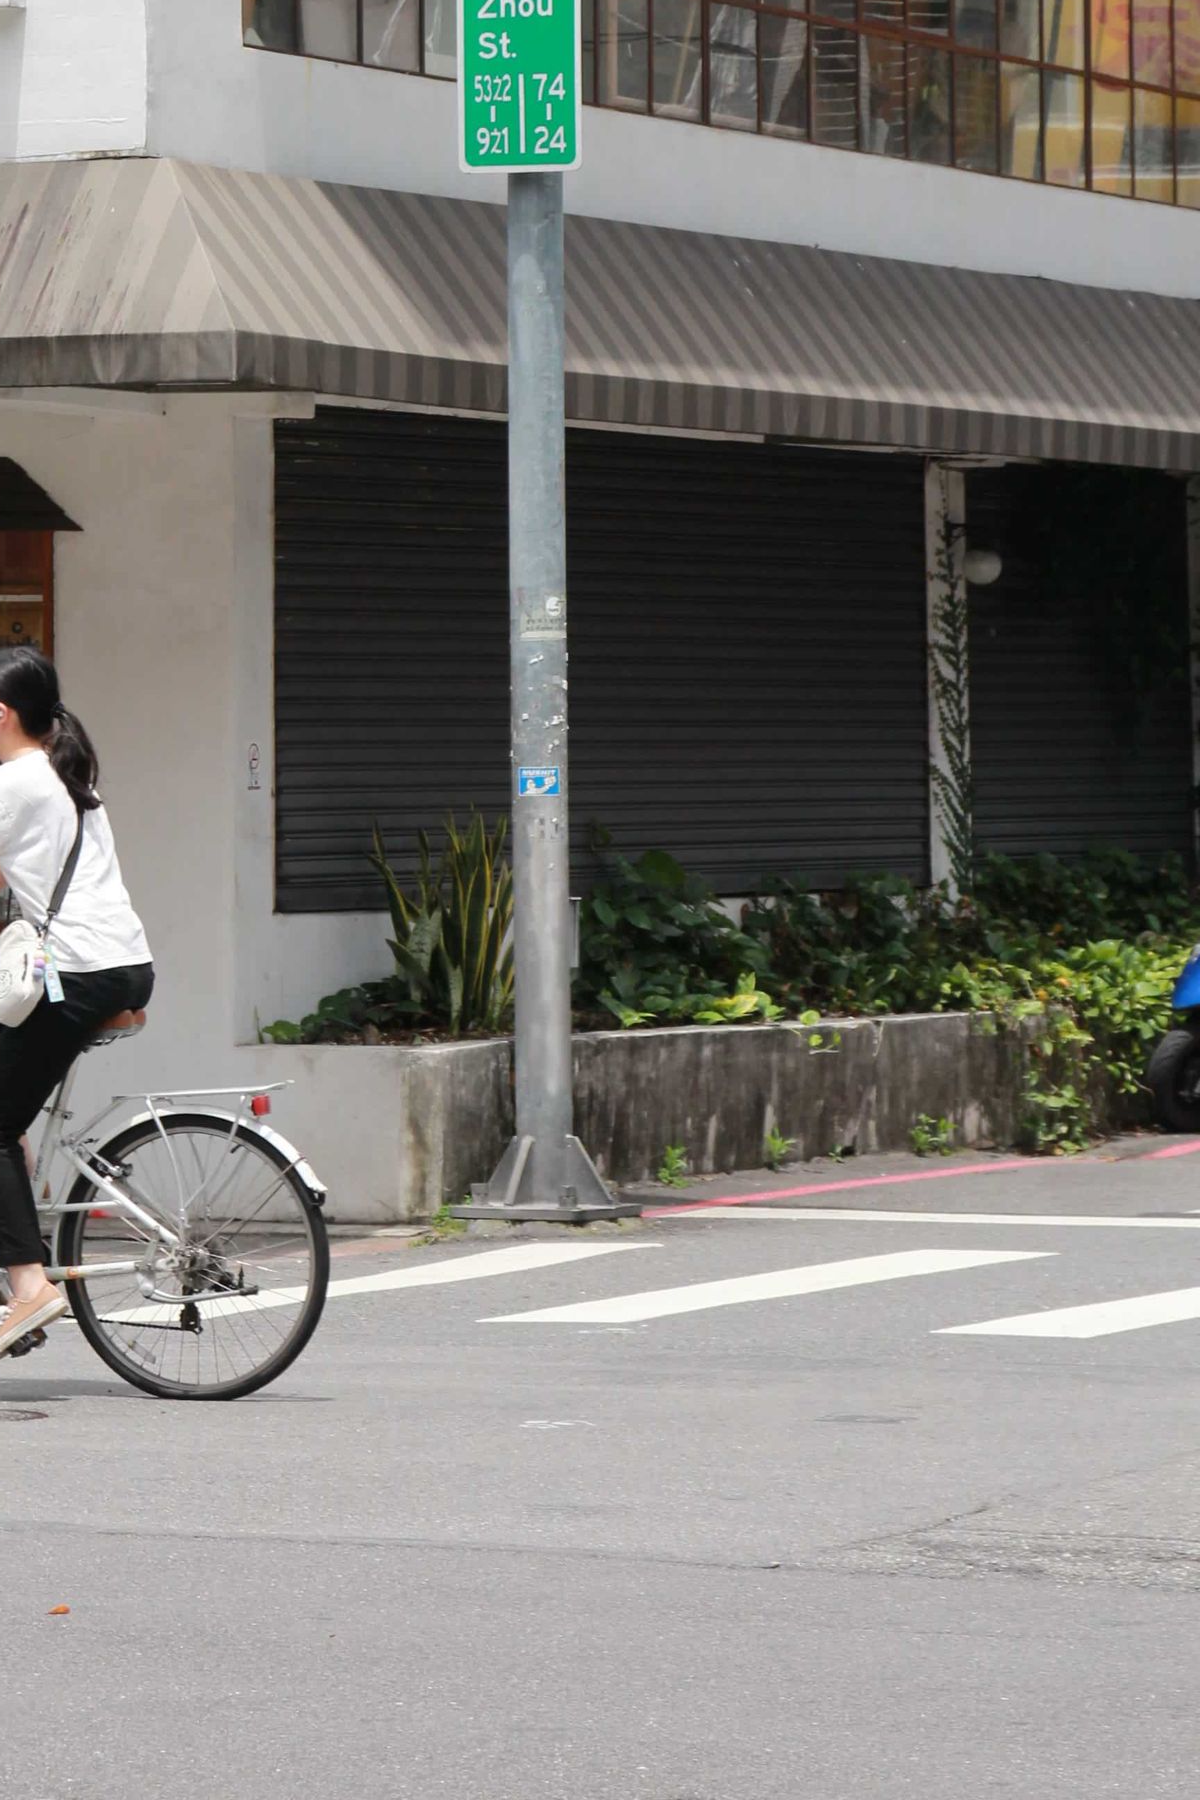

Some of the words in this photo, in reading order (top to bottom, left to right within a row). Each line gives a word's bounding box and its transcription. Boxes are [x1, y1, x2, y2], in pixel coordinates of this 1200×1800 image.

[478, 31, 517, 60] St.
[532, 72, 566, 101] 74
[533, 125, 567, 155] 24
